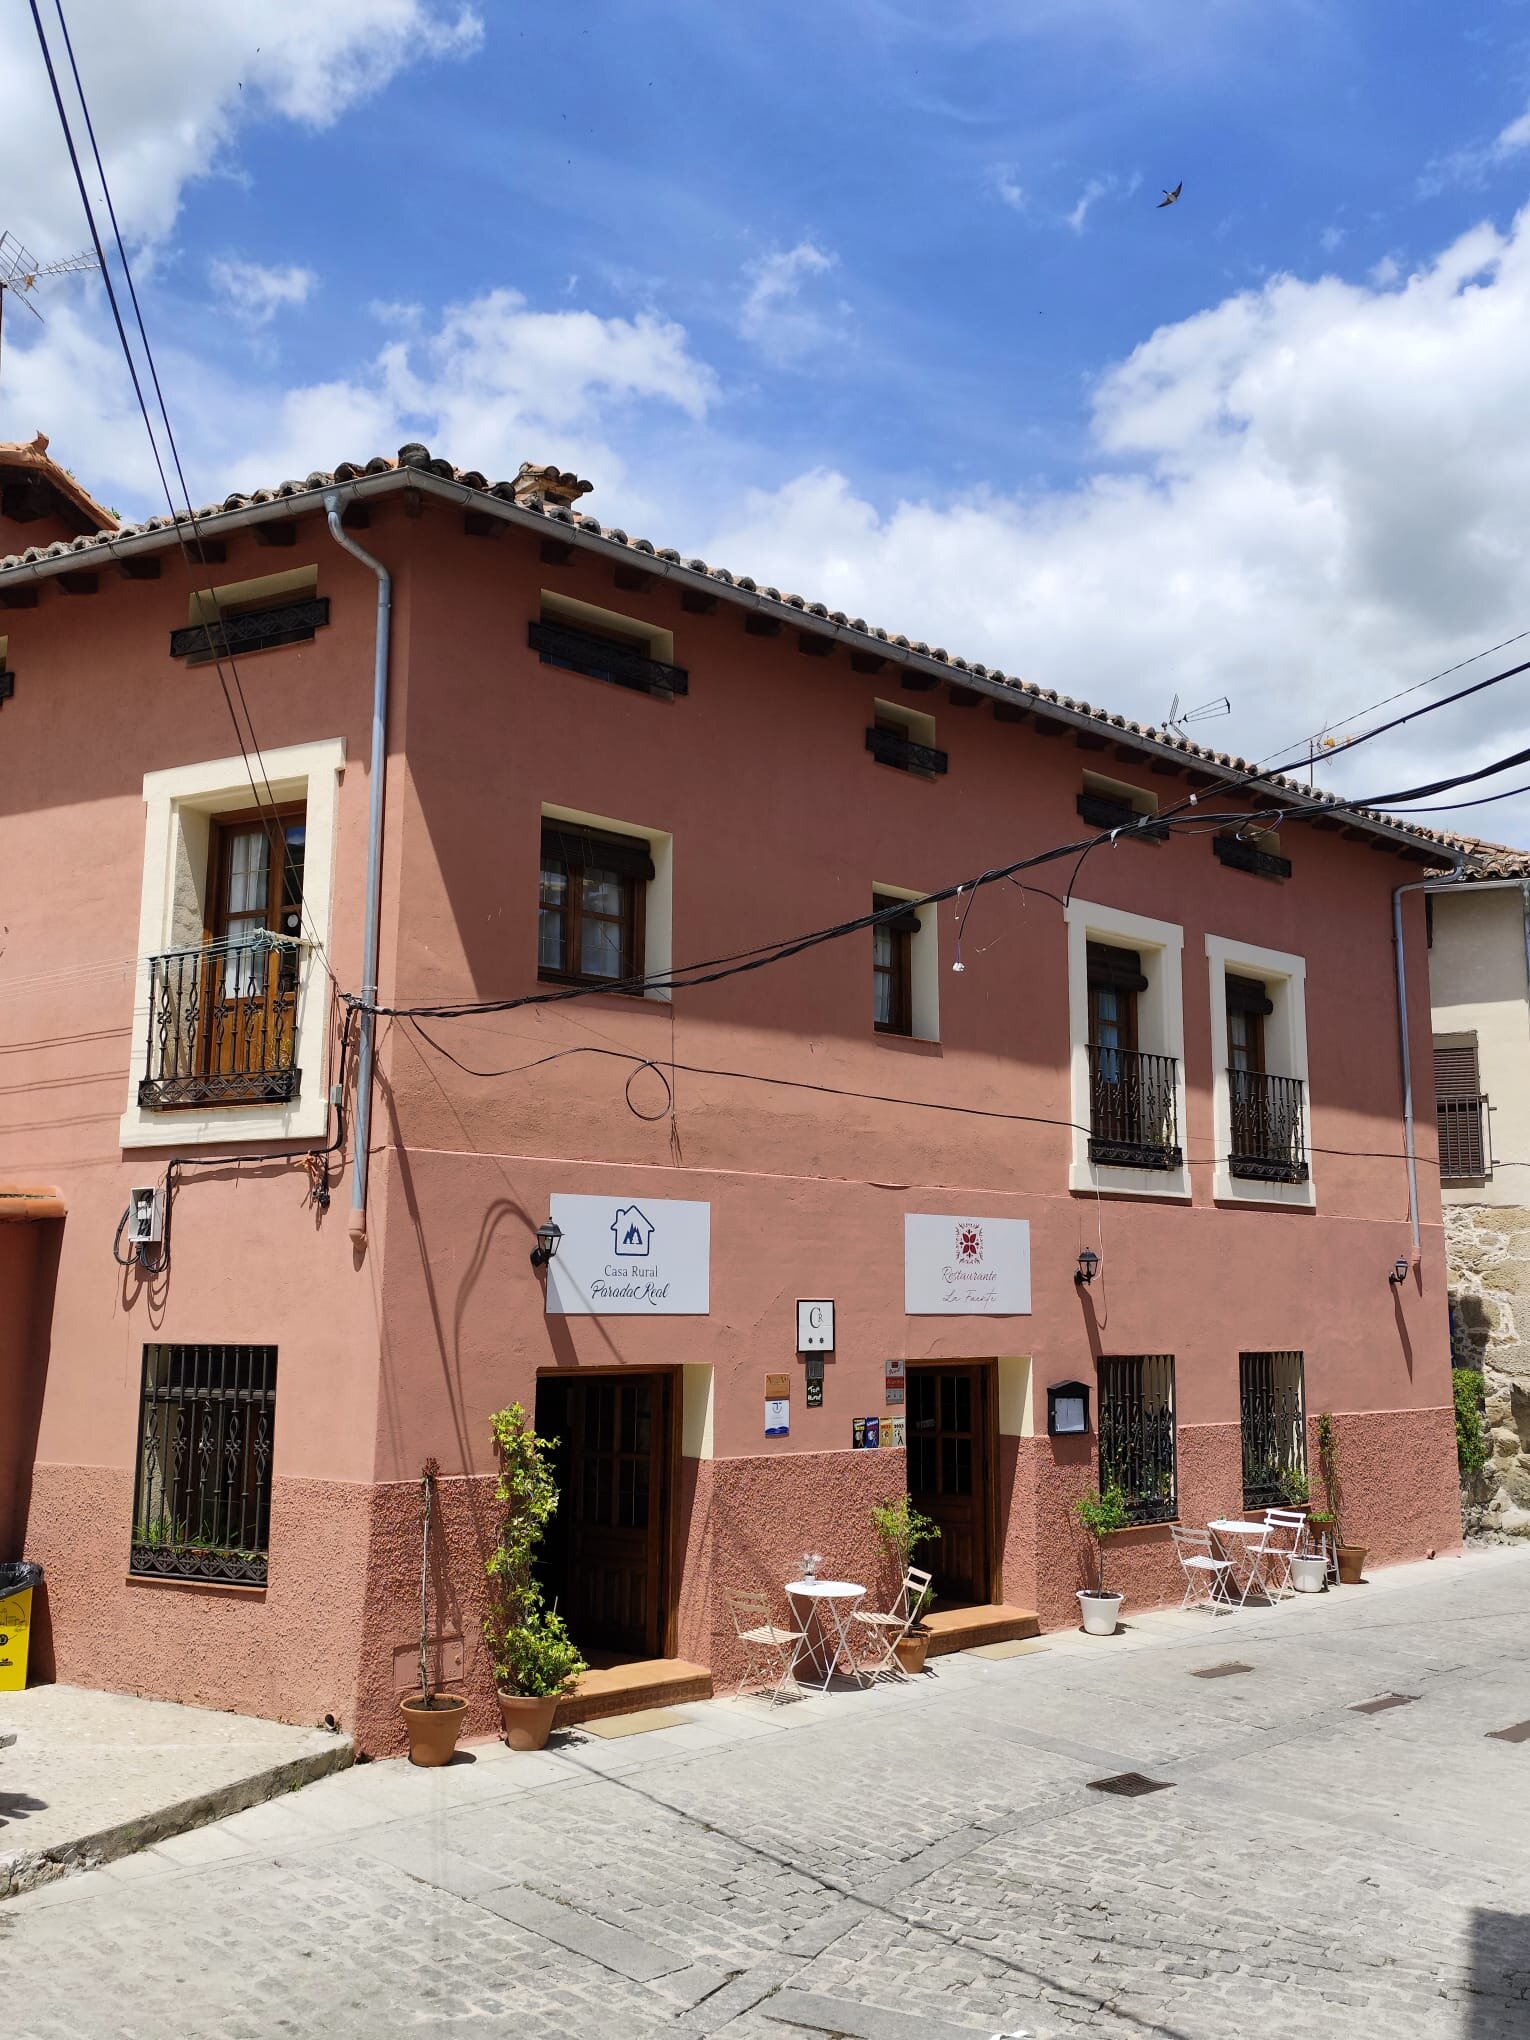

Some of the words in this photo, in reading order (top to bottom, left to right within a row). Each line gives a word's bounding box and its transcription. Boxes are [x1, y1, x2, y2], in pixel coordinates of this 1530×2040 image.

[604, 1264, 628, 1277] Casa
[632, 1264, 658, 1278] Rural
[941, 1265, 998, 1284] Restaurante
[590, 1279, 634, 1300] Parada
[633, 1281, 671, 1306] Real
